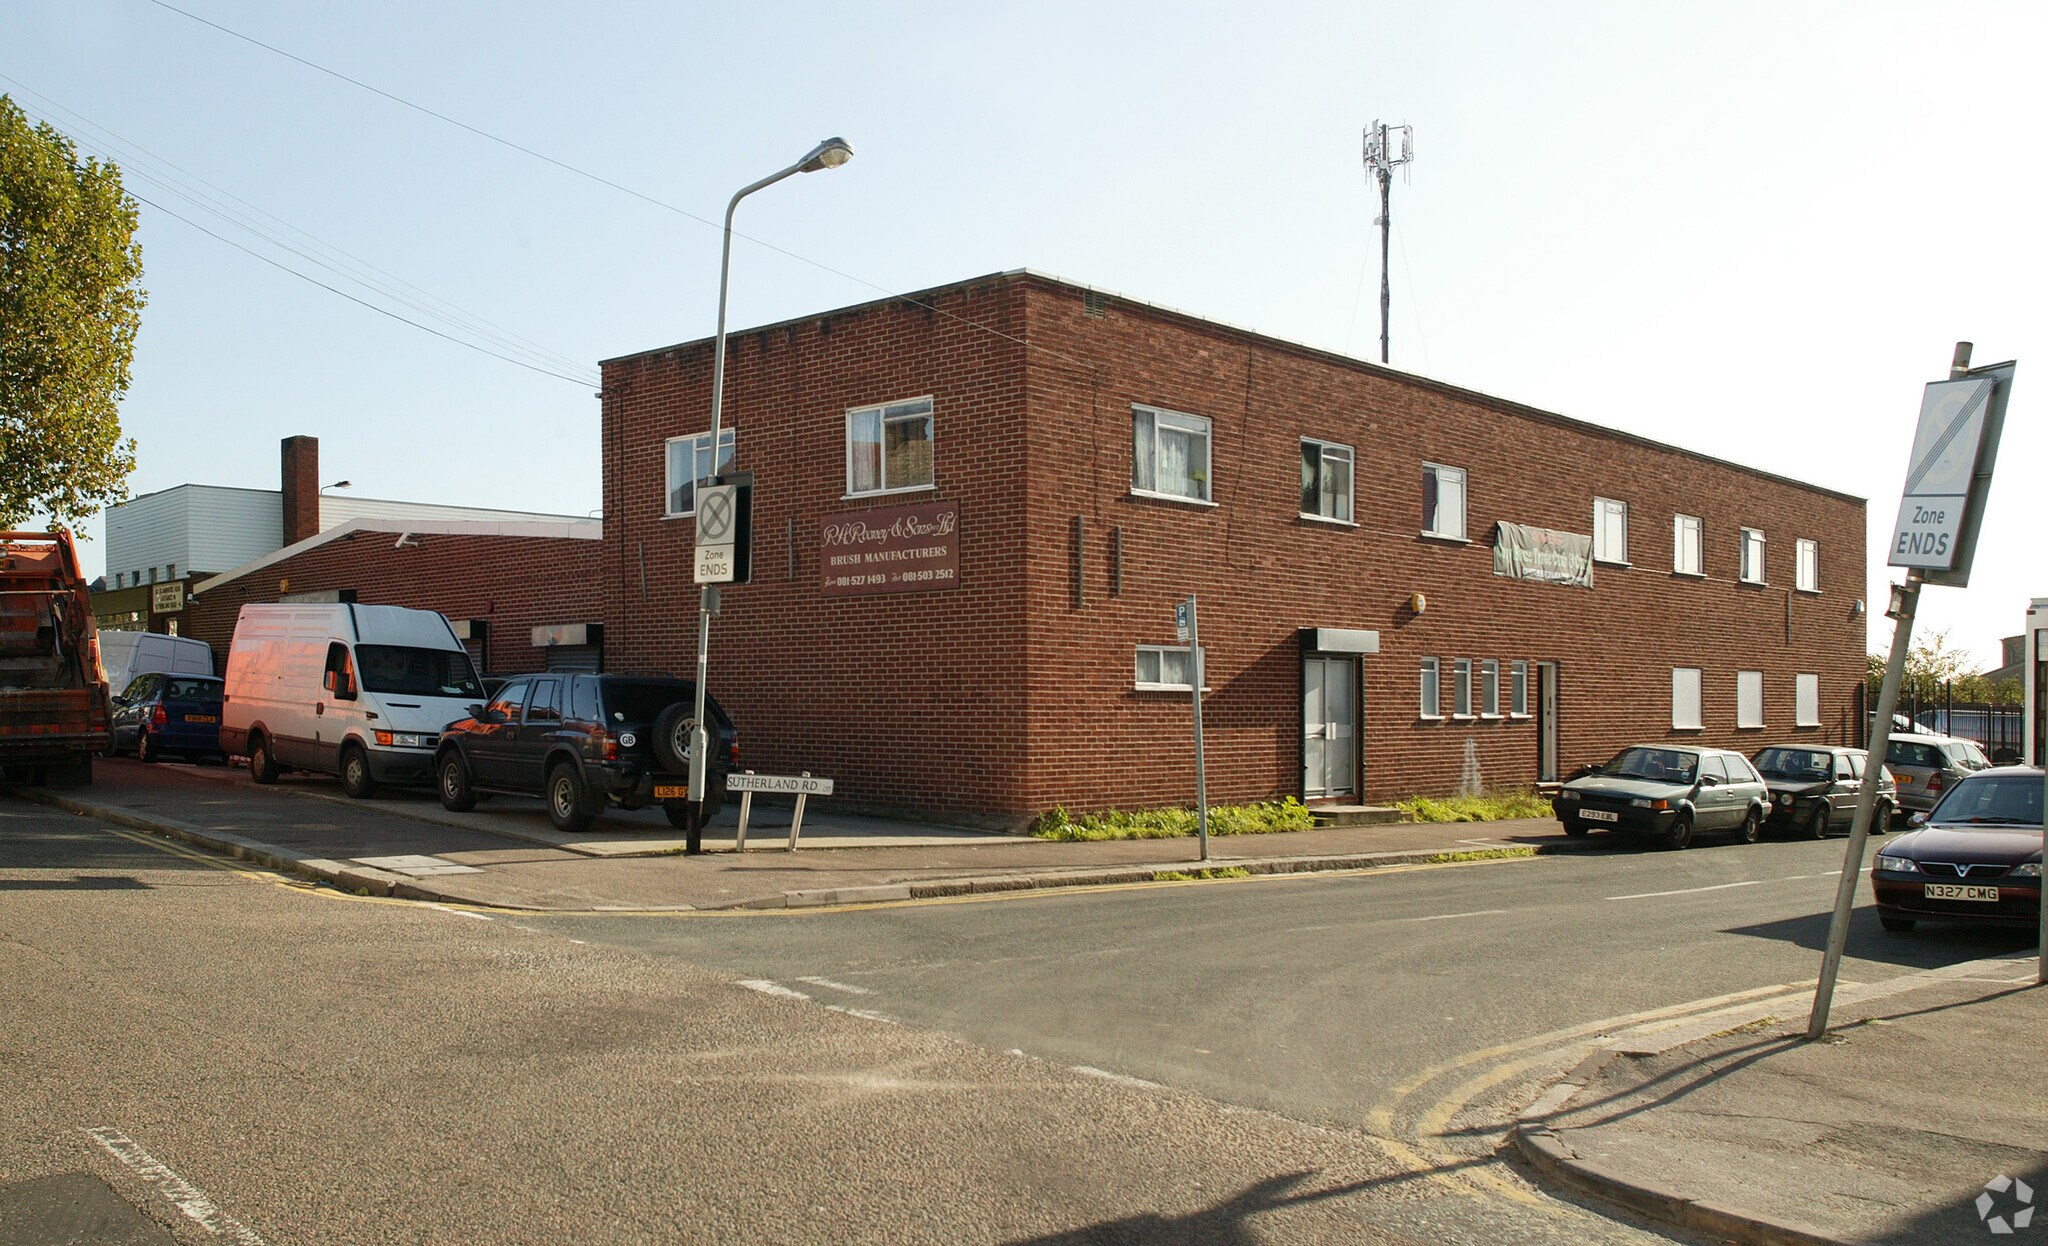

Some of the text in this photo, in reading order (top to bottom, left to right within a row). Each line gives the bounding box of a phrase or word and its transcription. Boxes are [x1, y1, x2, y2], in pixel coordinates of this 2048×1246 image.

[1912, 506, 1945, 524] Zone
[891, 517, 903, 538] &
[902, 515, 933, 539] Sons
[932, 511, 959, 537] Ltd
[1896, 532, 1950, 556] ENDS
[705, 550, 724, 560] Zone
[830, 545, 948, 566] BRUSH MANUFACTURERS
[700, 563, 728, 576] ENDS
[867, 573, 886, 585] 1493
[935, 568, 954, 580] 2512
[1178, 606, 1186, 617] P
[621, 735, 634, 745] GB
[727, 776, 798, 790] SUTHERLAND
[657, 787, 676, 796] L126
[1926, 885, 1997, 900] N327 CMG
